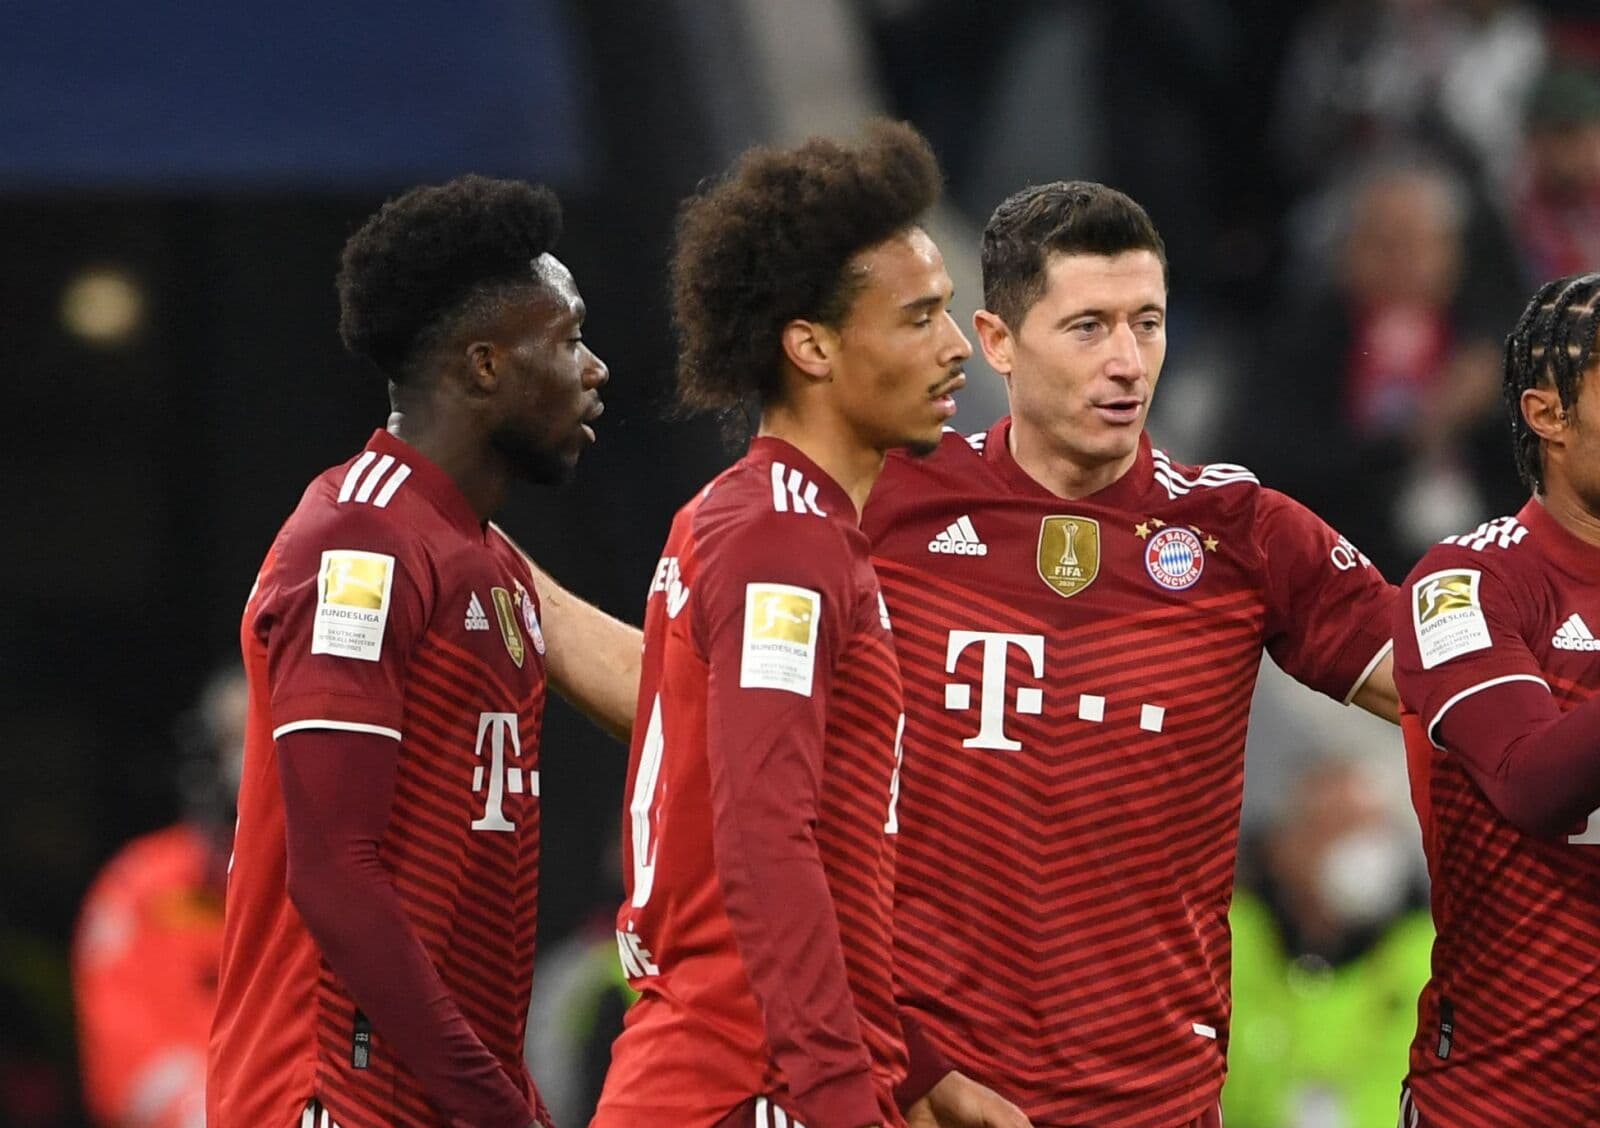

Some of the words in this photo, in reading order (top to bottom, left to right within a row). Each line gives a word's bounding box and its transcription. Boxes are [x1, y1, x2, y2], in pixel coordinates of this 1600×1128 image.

[927, 538, 988, 557] adidas
[1151, 538, 1166, 553] FC
[1165, 531, 1202, 558] BAYERN
[1055, 565, 1083, 577] FIFA
[320, 608, 380, 623] BUNDESLIGA
[1420, 610, 1476, 637] BUNDESLIGA
